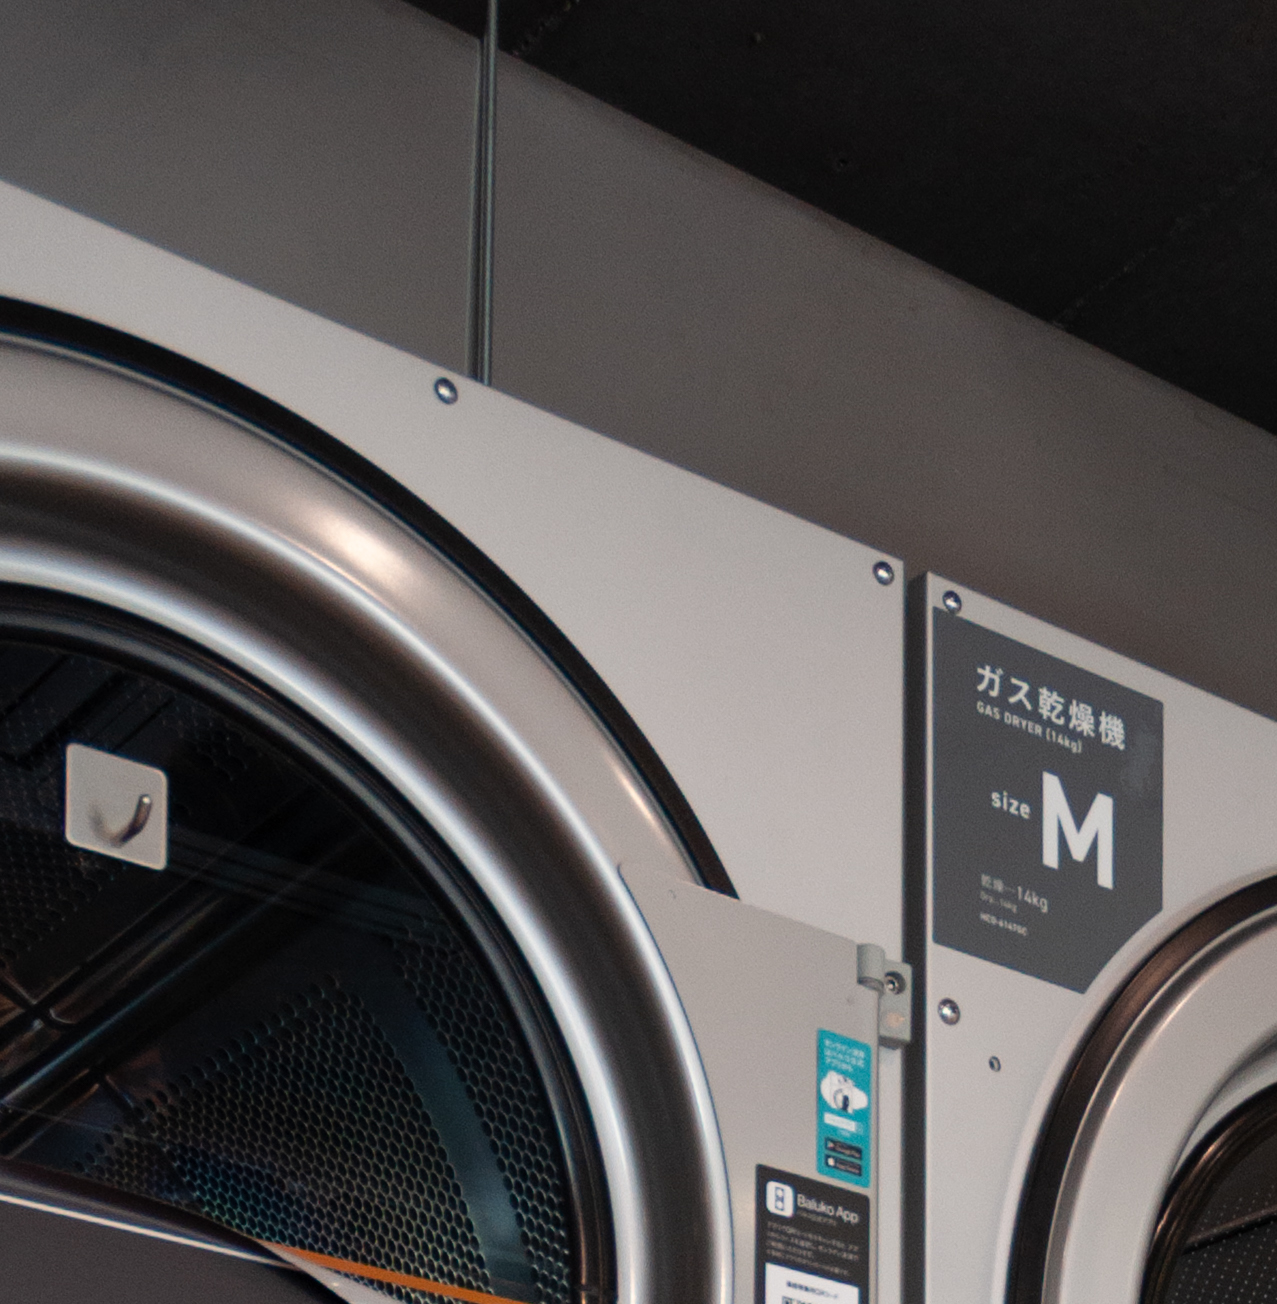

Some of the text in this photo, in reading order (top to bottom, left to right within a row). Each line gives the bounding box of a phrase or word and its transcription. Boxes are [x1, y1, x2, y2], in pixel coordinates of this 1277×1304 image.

[976, 701, 1082, 754] GAS DRYER (14kg)
[977, 665, 1125, 751] ガス乾燥機
[991, 771, 1114, 890] size M
[797, 1193, 834, 1216] Baluko
[836, 1206, 859, 1226] App
